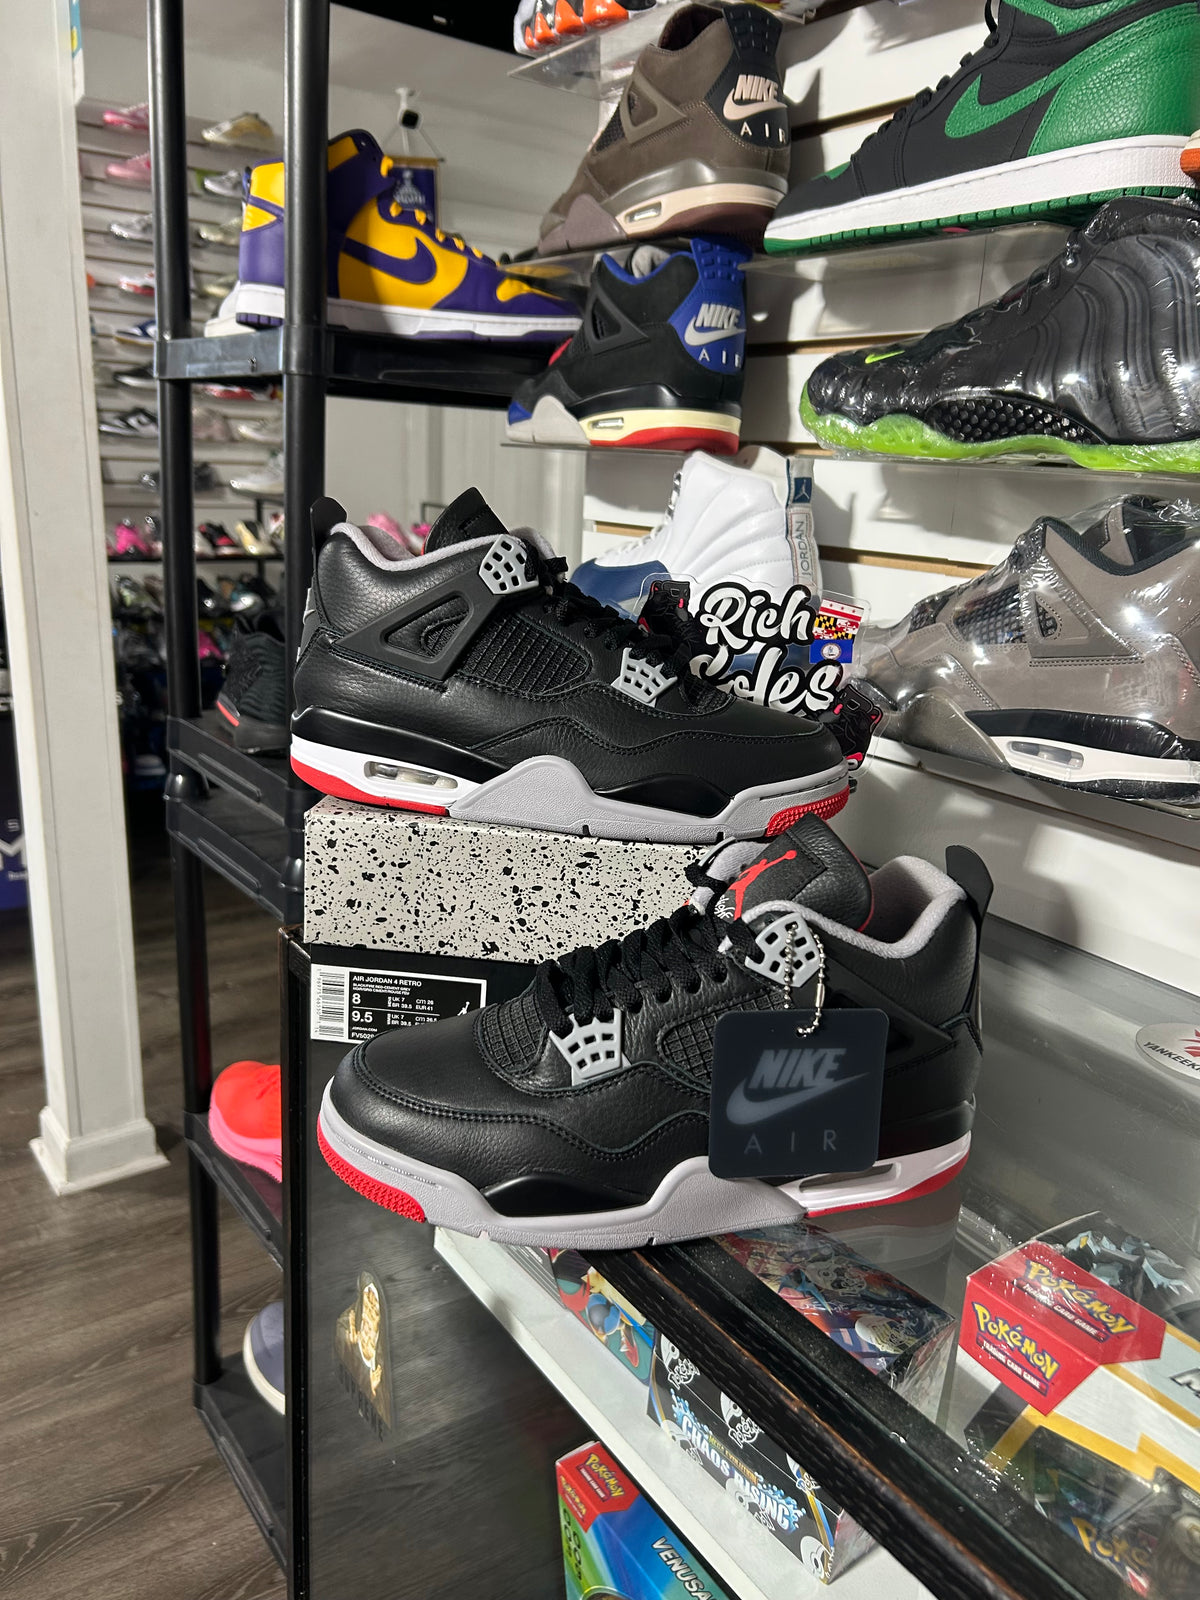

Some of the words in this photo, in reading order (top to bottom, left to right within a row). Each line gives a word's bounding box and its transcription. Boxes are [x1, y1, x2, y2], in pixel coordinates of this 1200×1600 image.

[734, 74, 778, 103] NIKE
[741, 121, 786, 144] AIR
[695, 303, 741, 330] NIKE
[795, 520, 812, 576] JORDAN
[700, 583, 815, 651] Rich
[352, 993, 361, 1004] 8
[351, 1010, 373, 1023] 9.5
[749, 1048, 847, 1088] NIKE
[743, 1129, 838, 1156] AIR
[1024, 1258, 1138, 1335] Pokémon
[1053, 1304, 1075, 1321] CARD
[1074, 1316, 1100, 1336] GAME
[971, 1301, 1062, 1384] Pokémon
[1006, 1356, 1023, 1375] CARD
[1022, 1369, 1042, 1390] GAME
[681, 1415, 731, 1478] CHAOS
[584, 1452, 625, 1498] Pokémon
